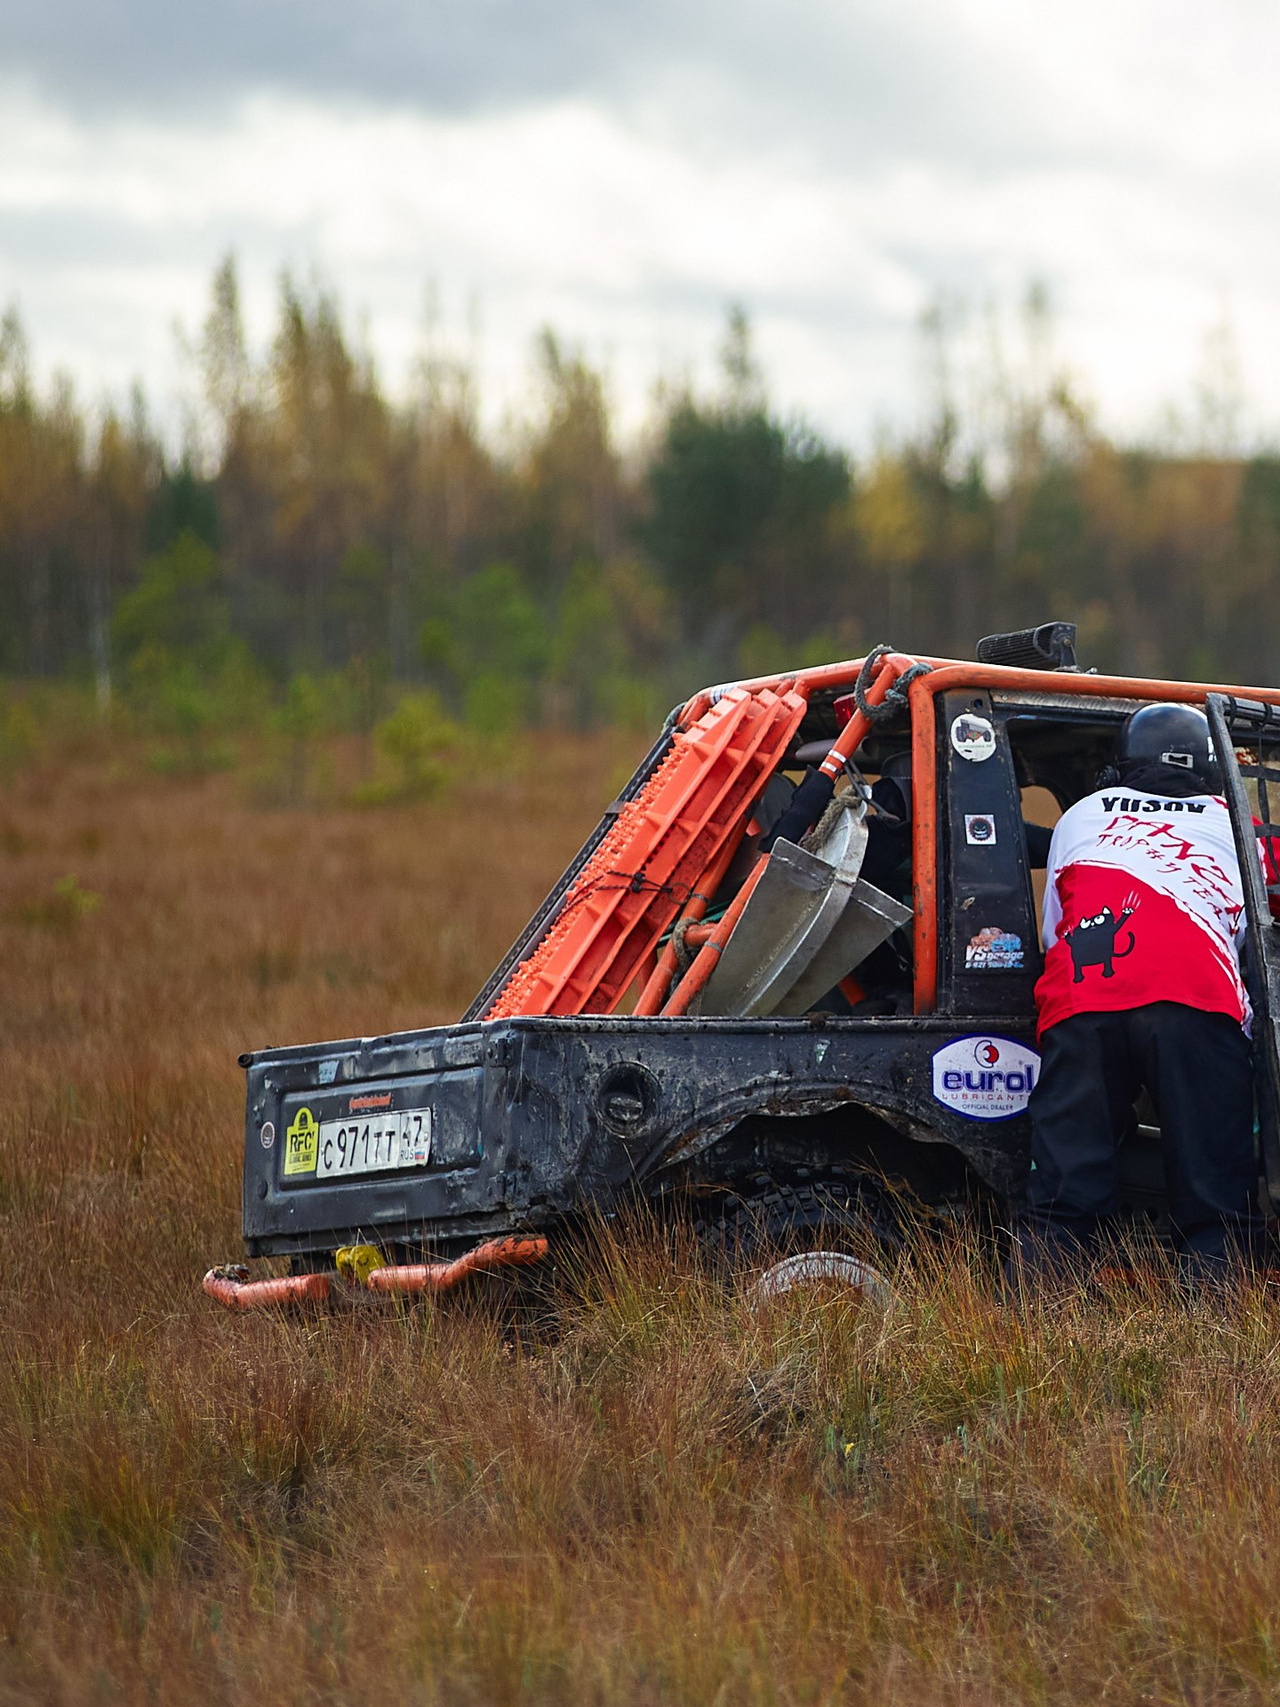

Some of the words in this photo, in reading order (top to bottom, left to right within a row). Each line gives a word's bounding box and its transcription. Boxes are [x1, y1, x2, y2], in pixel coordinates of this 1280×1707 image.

[965, 945, 989, 961] VS
[942, 1065, 1034, 1092] eurol
[962, 1103, 990, 1111] OFFICIAL
[290, 1132, 312, 1153] RFC
[400, 1149, 414, 1160] RUS
